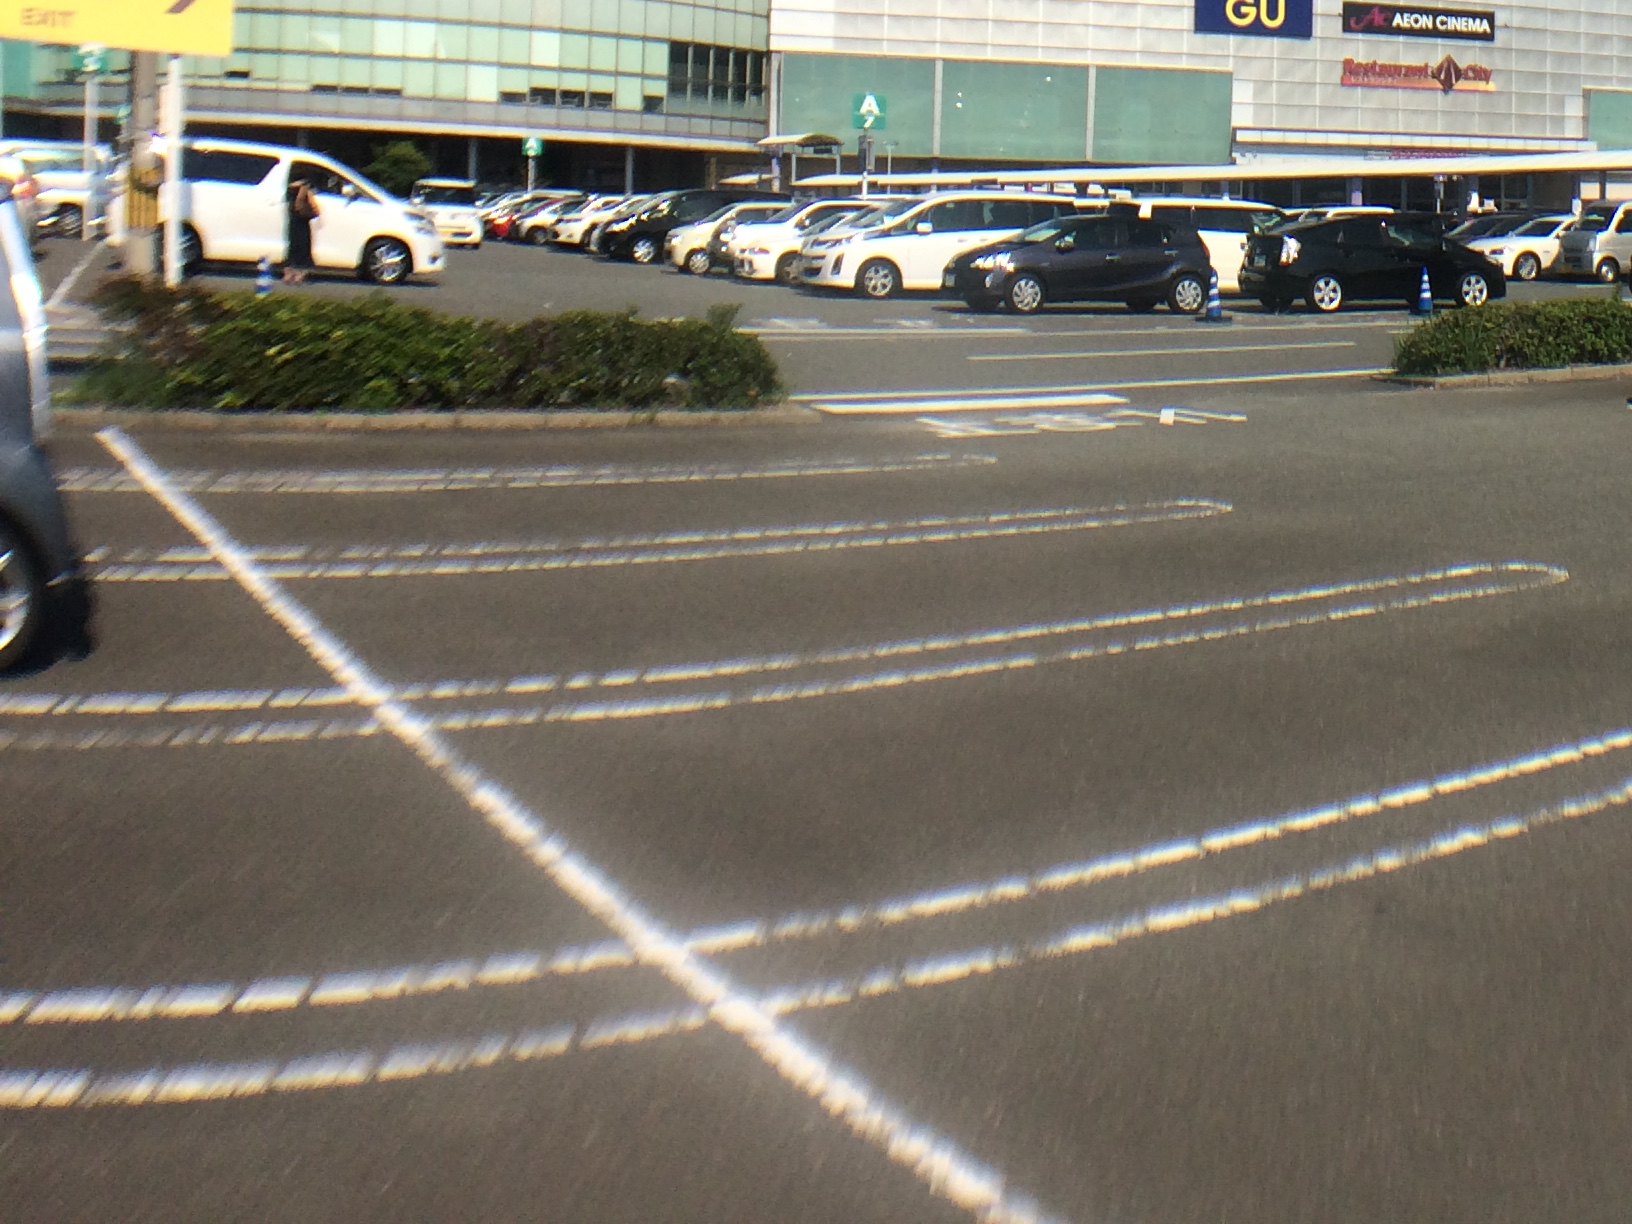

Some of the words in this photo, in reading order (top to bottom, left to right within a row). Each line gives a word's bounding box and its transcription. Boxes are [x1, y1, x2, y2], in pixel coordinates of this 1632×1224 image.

[20, 7, 75, 27] EXIT
[1392, 12, 1432, 30] AEON
[1435, 14, 1491, 34] CINEMA
[859, 93, 881, 116] A
